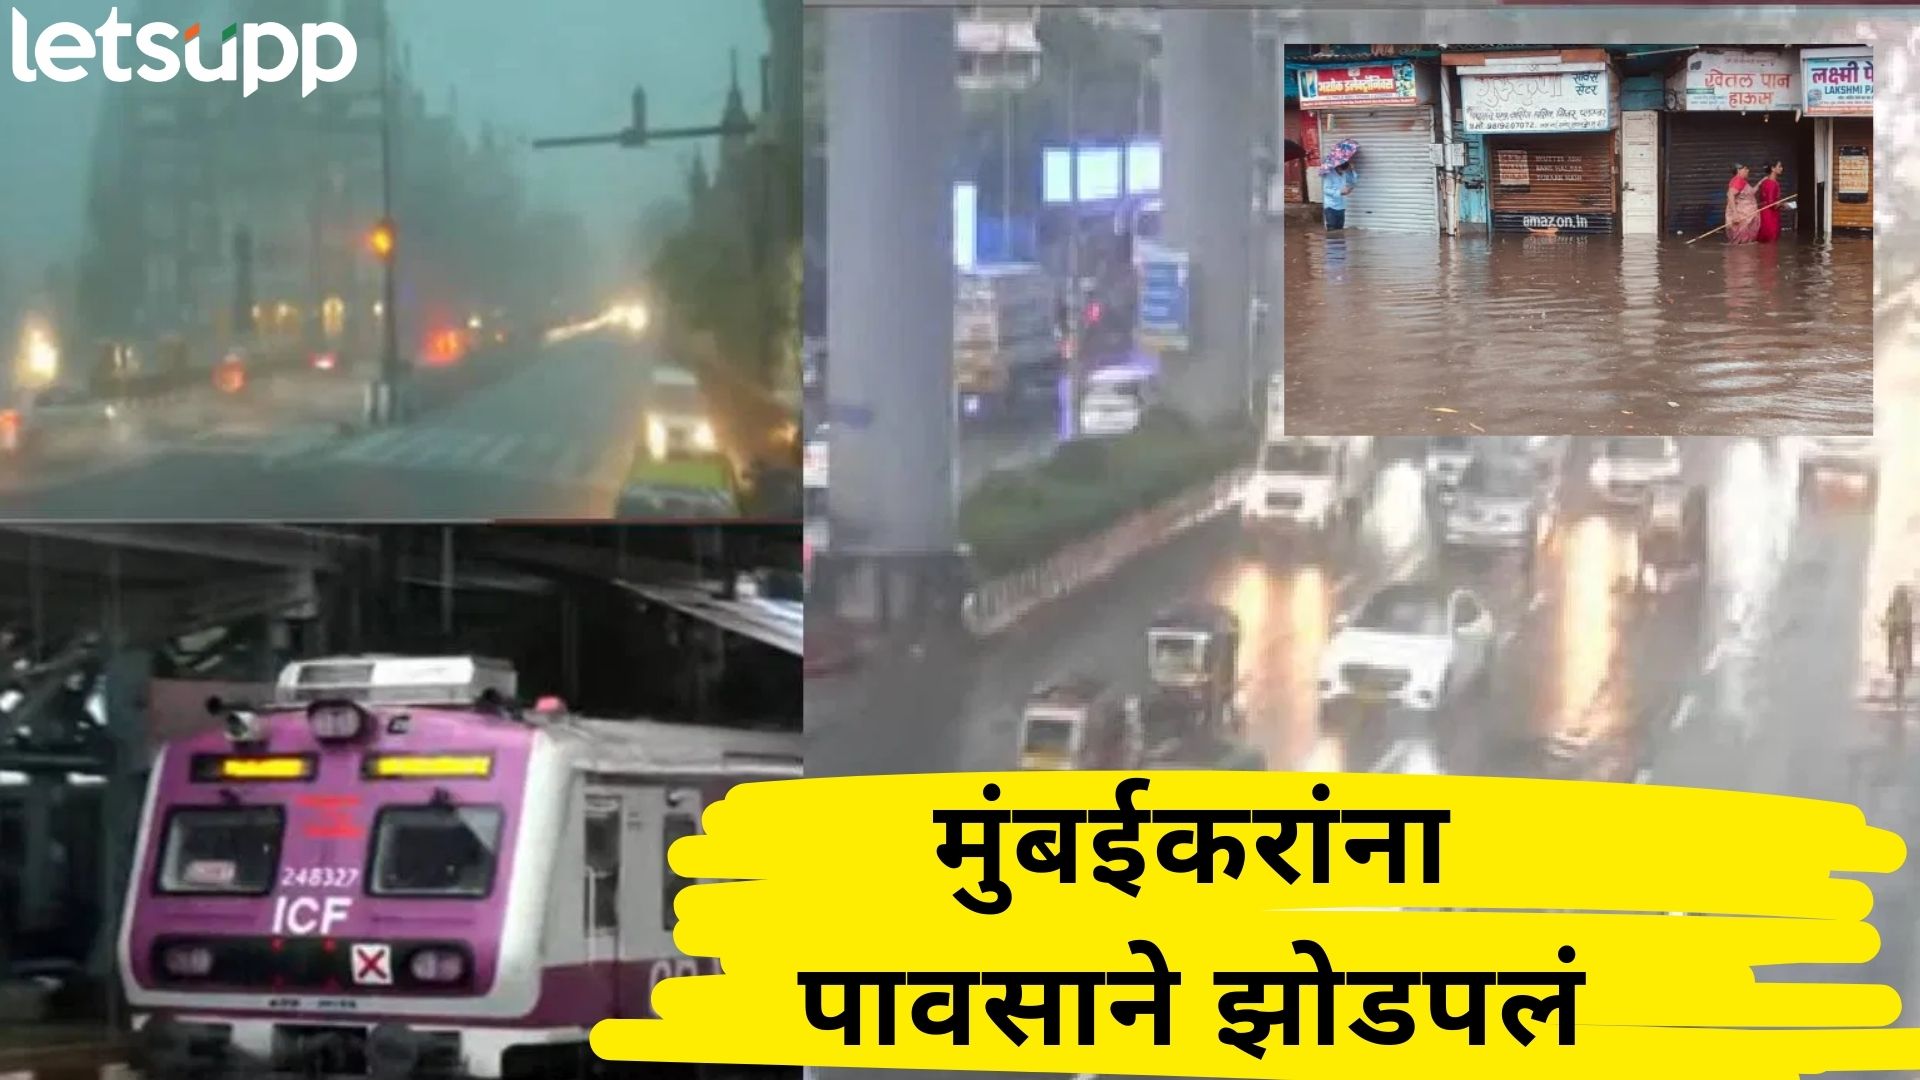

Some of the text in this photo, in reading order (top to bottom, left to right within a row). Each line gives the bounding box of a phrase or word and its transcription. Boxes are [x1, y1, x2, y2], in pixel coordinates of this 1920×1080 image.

[1760, 73, 1792, 89] पान
[1811, 60, 1860, 85] लक्ष्मी
[1824, 85, 1863, 95] LAKSHMI
[1523, 214, 1588, 228] amazon.in
[281, 867, 359, 888] 248327
[272, 895, 353, 934] ICF
